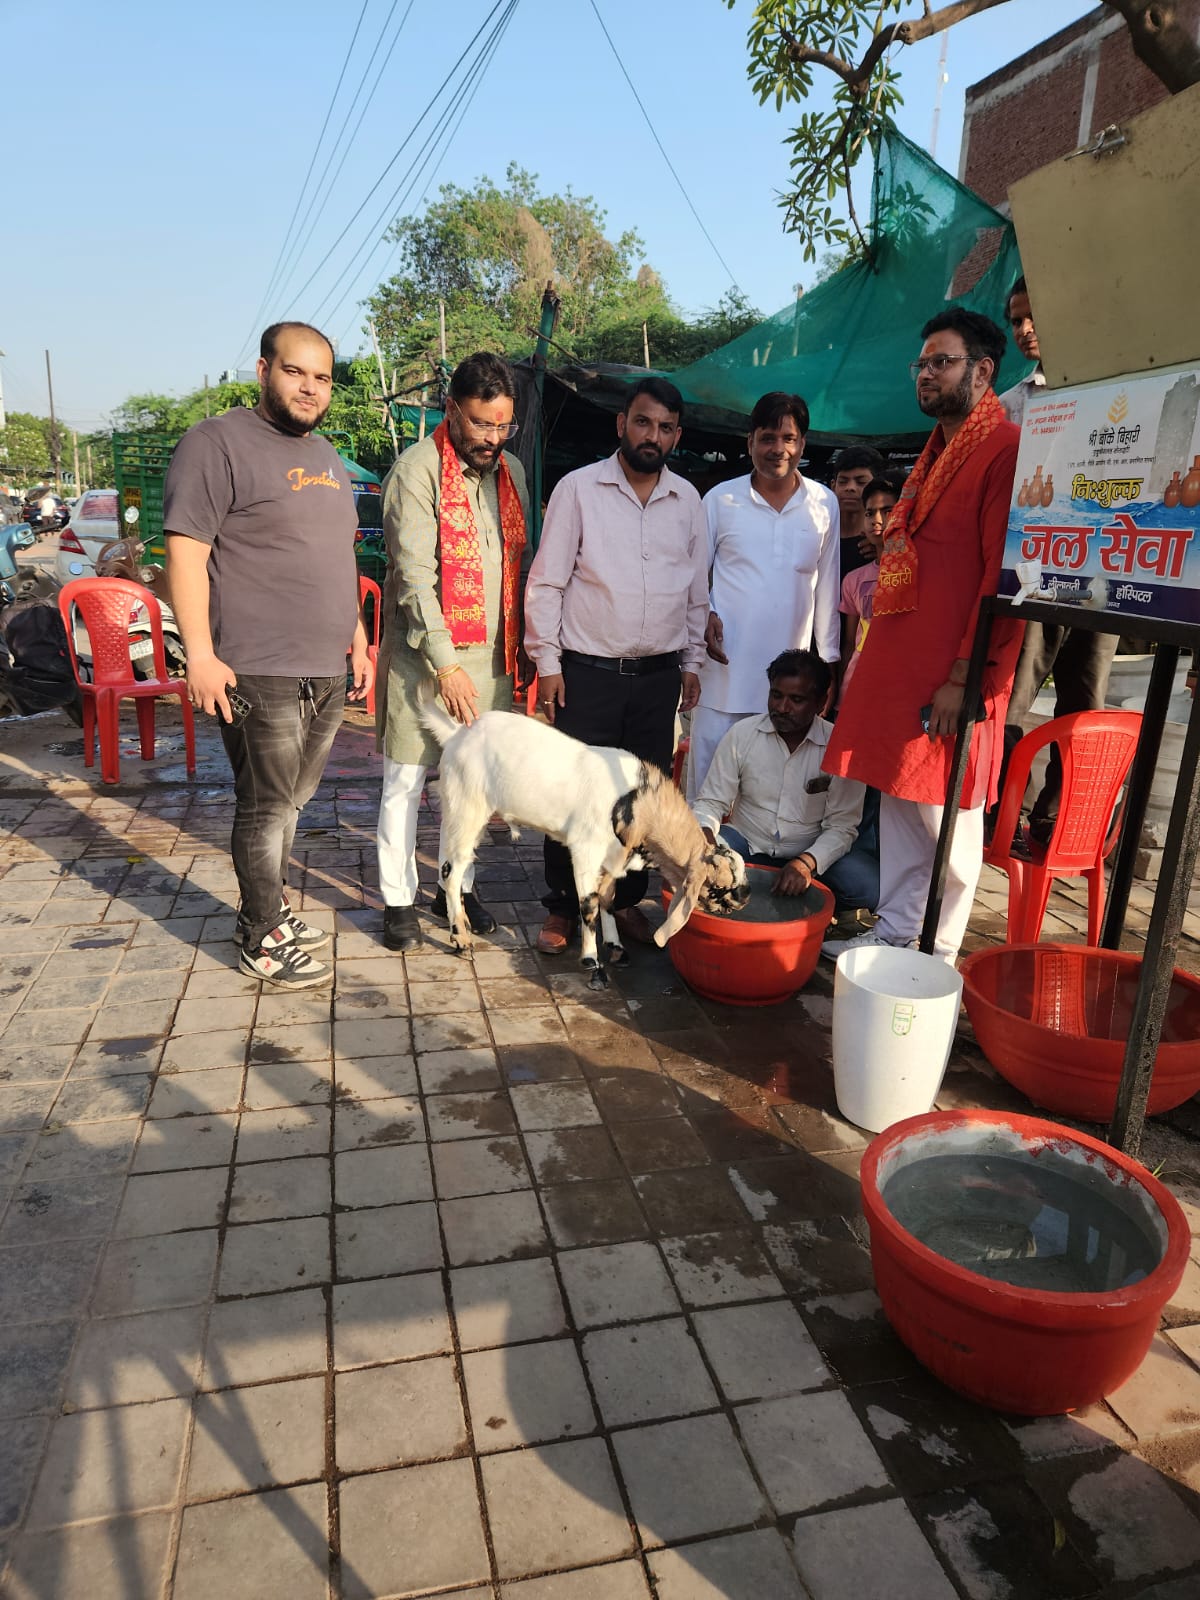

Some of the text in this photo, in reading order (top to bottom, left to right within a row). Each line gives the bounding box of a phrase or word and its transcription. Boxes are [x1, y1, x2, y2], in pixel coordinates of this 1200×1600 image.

[1088, 429, 1098, 446] श्री
[1117, 424, 1141, 447] बिहारी
[287, 467, 341, 491] Jordan
[1071, 474, 1144, 508] निःशुल्क
[1021, 512, 1194, 579] जल सेवा
[879, 567, 913, 587] बिहारी
[1115, 584, 1154, 603] हॉस्पिटल
